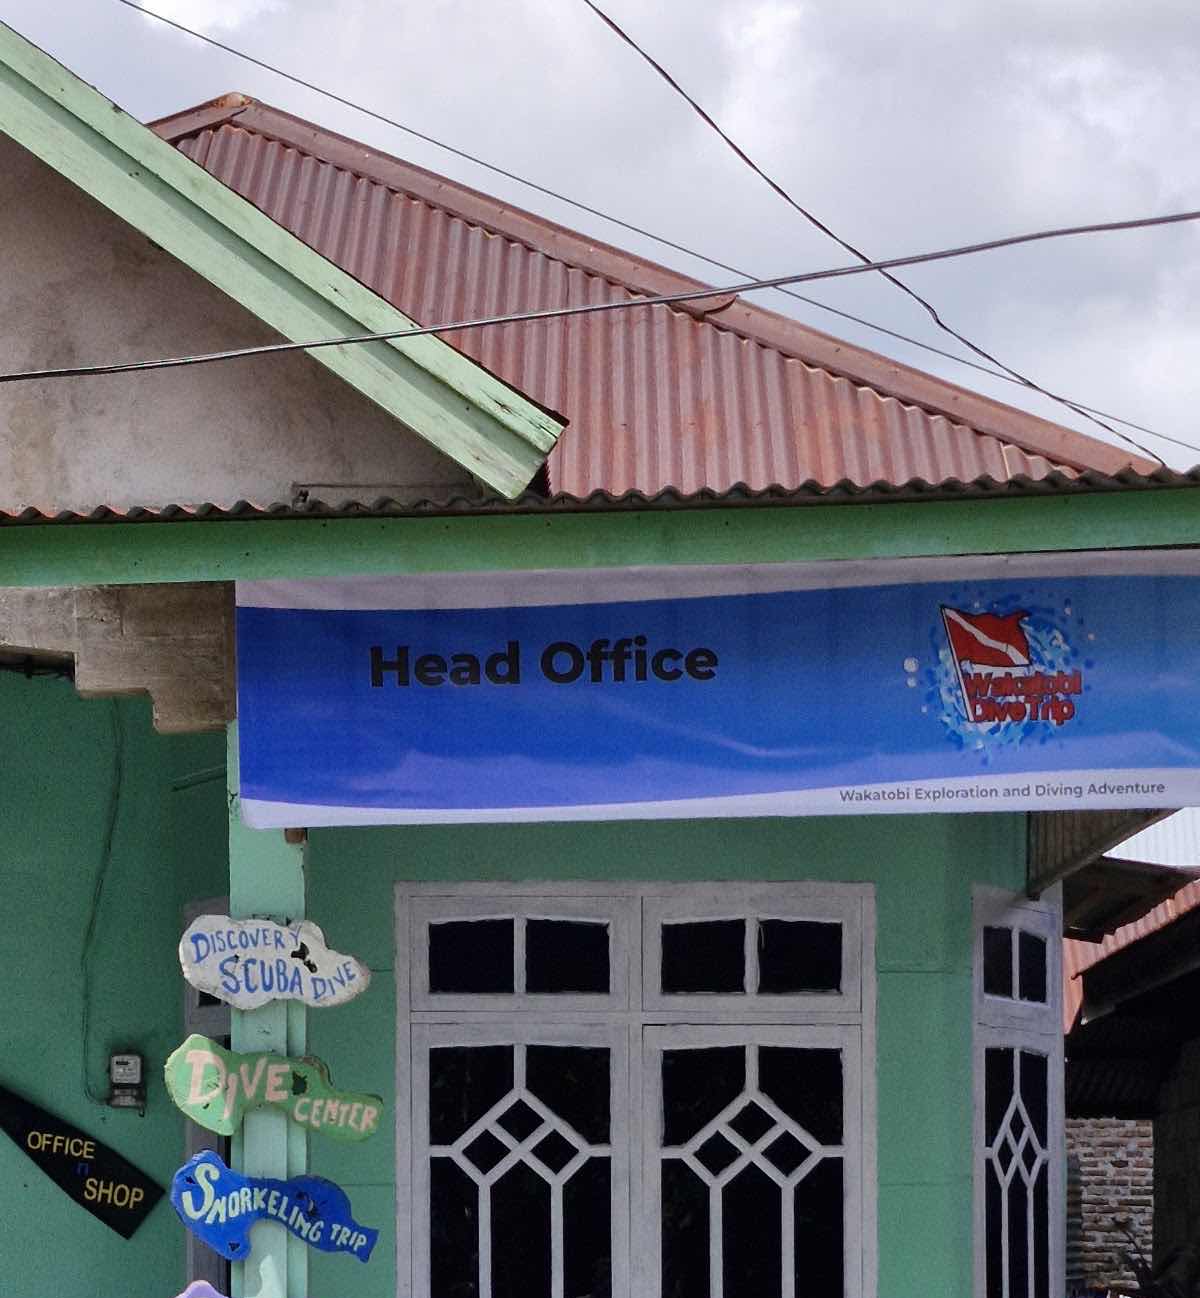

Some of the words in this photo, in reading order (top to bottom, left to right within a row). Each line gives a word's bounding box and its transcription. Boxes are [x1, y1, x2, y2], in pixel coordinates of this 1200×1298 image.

[370, 640, 521, 687] Head
[540, 635, 719, 684] Office
[963, 668, 1082, 696] Wakatobi
[839, 787, 910, 802] Wakatobi
[914, 784, 999, 802] Exploration
[1002, 783, 1031, 797] and
[1035, 783, 1083, 798] Diving
[1087, 782, 1166, 796] Adventure
[190, 926, 303, 964] DISCOVERY
[218, 956, 304, 996] SCUBA
[310, 960, 357, 1001] DIVE
[185, 1049, 291, 1121] DIVE
[293, 1096, 378, 1133] CENTER
[27, 1130, 96, 1160] OFFICE
[84, 1177, 145, 1209] SHOP
[181, 1163, 325, 1242] SNORKELING
[329, 1223, 368, 1251] TRIP
